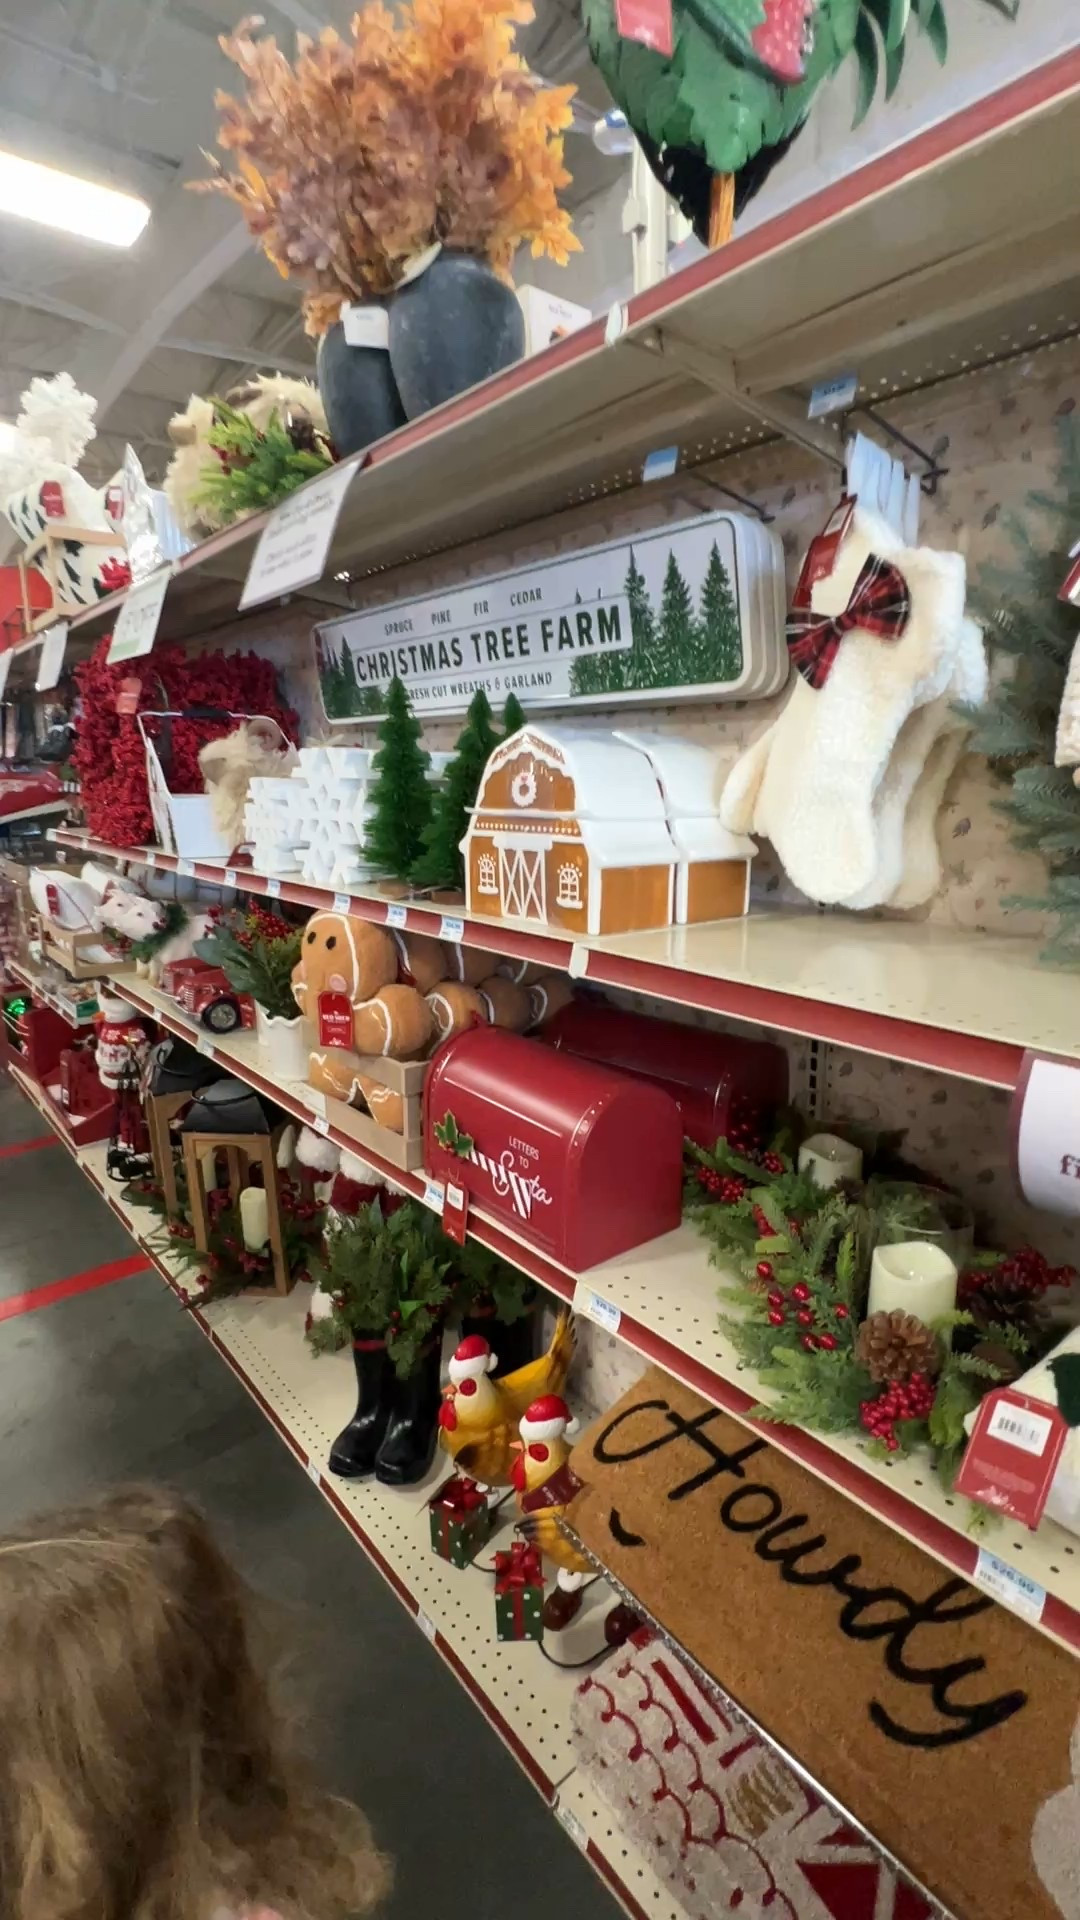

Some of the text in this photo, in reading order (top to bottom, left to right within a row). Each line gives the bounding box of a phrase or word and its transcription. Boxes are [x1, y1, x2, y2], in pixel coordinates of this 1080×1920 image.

[384, 587, 542, 636] SPRUCE PINE FIR CEDAR
[356, 604, 622, 681] CHRISTMAS TREE FARM
[407, 671, 552, 700] RESH CUT WREATHS & GARLAND
[508, 1135, 540, 1161] LETTERS
[519, 1155, 530, 1169] TO
[492, 1150, 553, 1206] Sta
[593, 1399, 1029, 1749] Howdy
